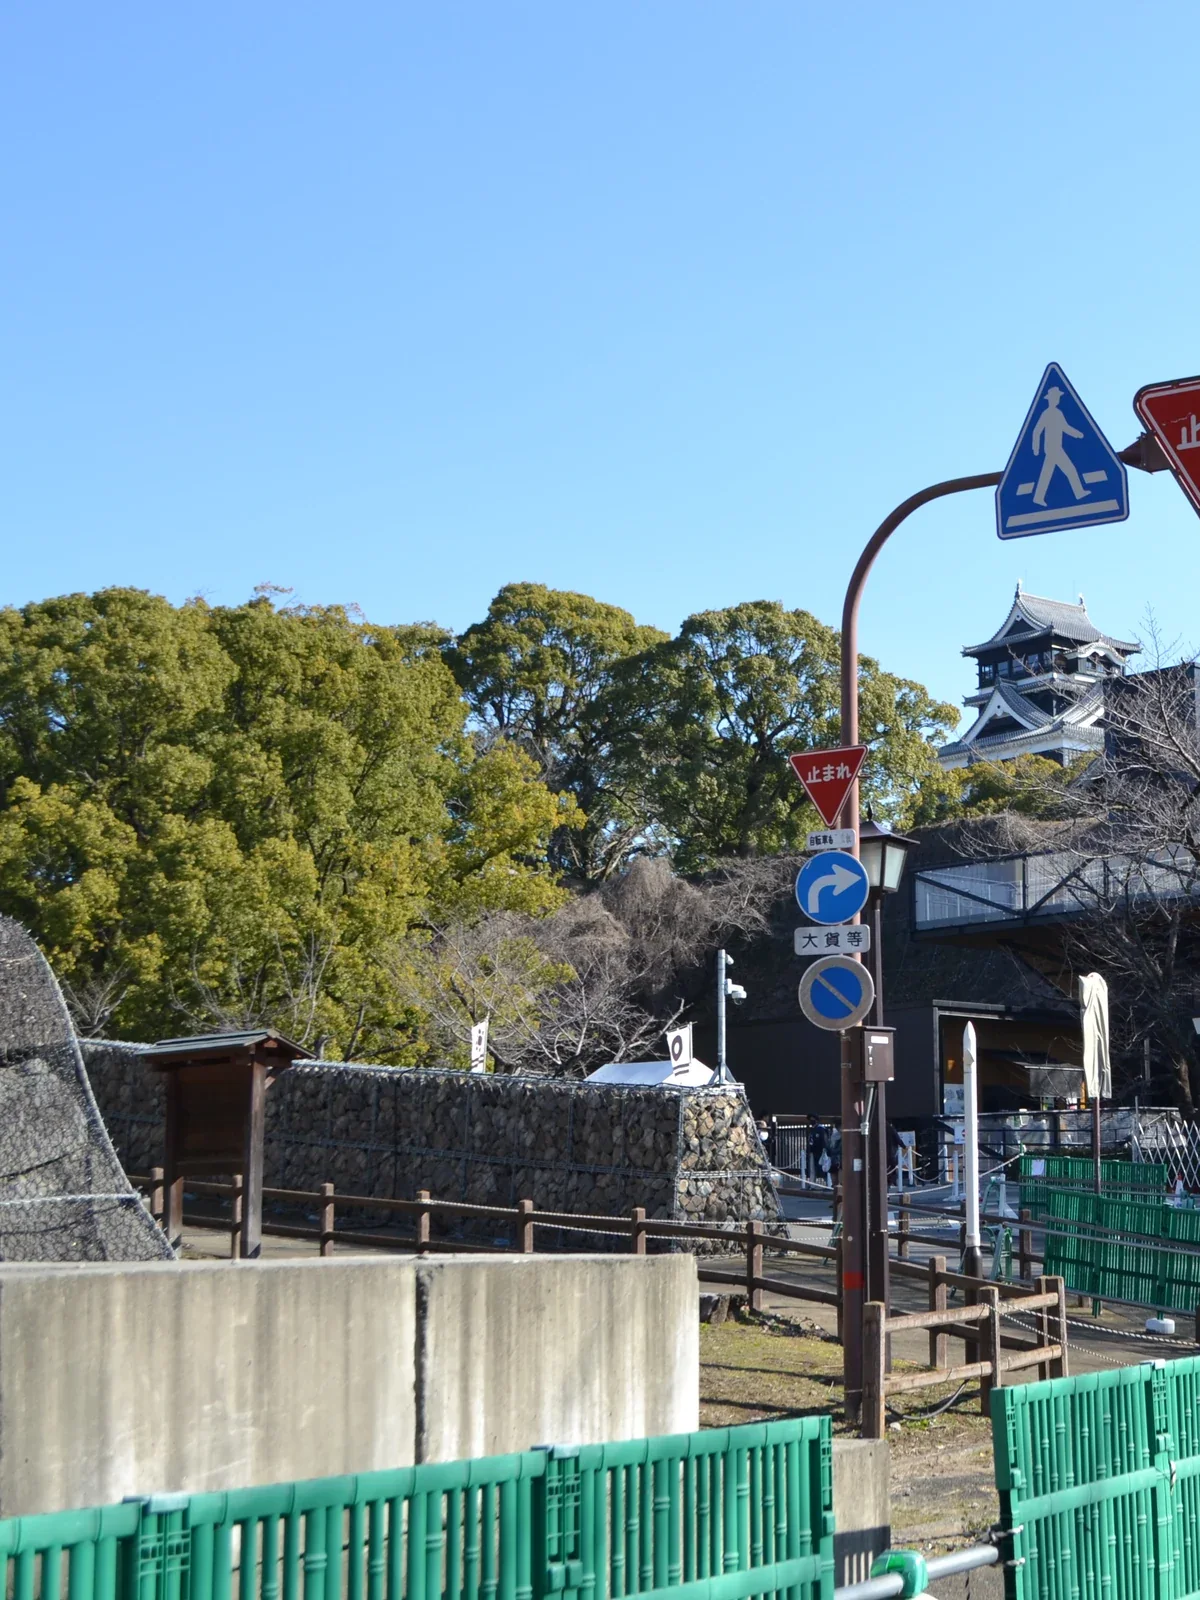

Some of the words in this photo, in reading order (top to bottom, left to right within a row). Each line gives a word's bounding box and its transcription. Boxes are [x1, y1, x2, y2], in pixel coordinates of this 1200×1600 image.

[806, 762, 852, 784] 止まれ
[802, 931, 863, 949] 大貨等
